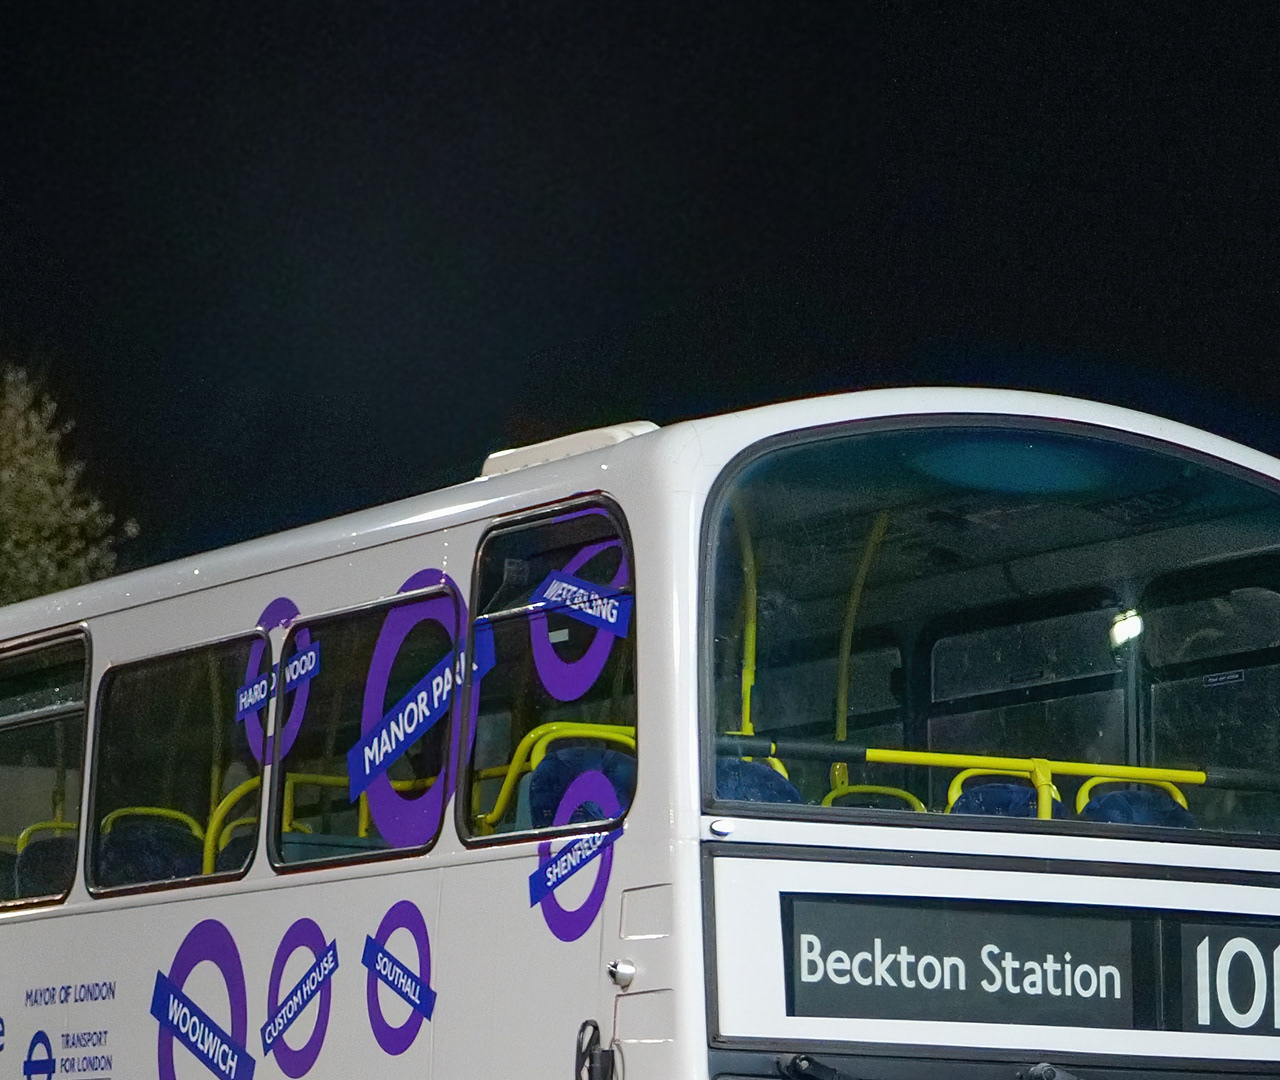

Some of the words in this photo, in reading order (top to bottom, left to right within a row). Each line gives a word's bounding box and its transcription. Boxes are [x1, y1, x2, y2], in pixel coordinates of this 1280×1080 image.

[364, 691, 430, 775] MANOR
[24, 987, 56, 1007] MAYOR
[60, 985, 72, 1004] OF
[73, 981, 116, 1003] LONDON
[375, 952, 421, 1004] SOUTHALL
[799, 933, 967, 992] Beckton
[980, 944, 1121, 999] Station
[265, 989, 303, 1044] CUSTOM
[302, 950, 336, 1001] HOUSE
[60, 1057, 76, 1073] FOR
[77, 1055, 113, 1072] LONDON
[61, 1030, 108, 1049] TRANSPORT
[168, 994, 238, 1079] WOOLWICH
